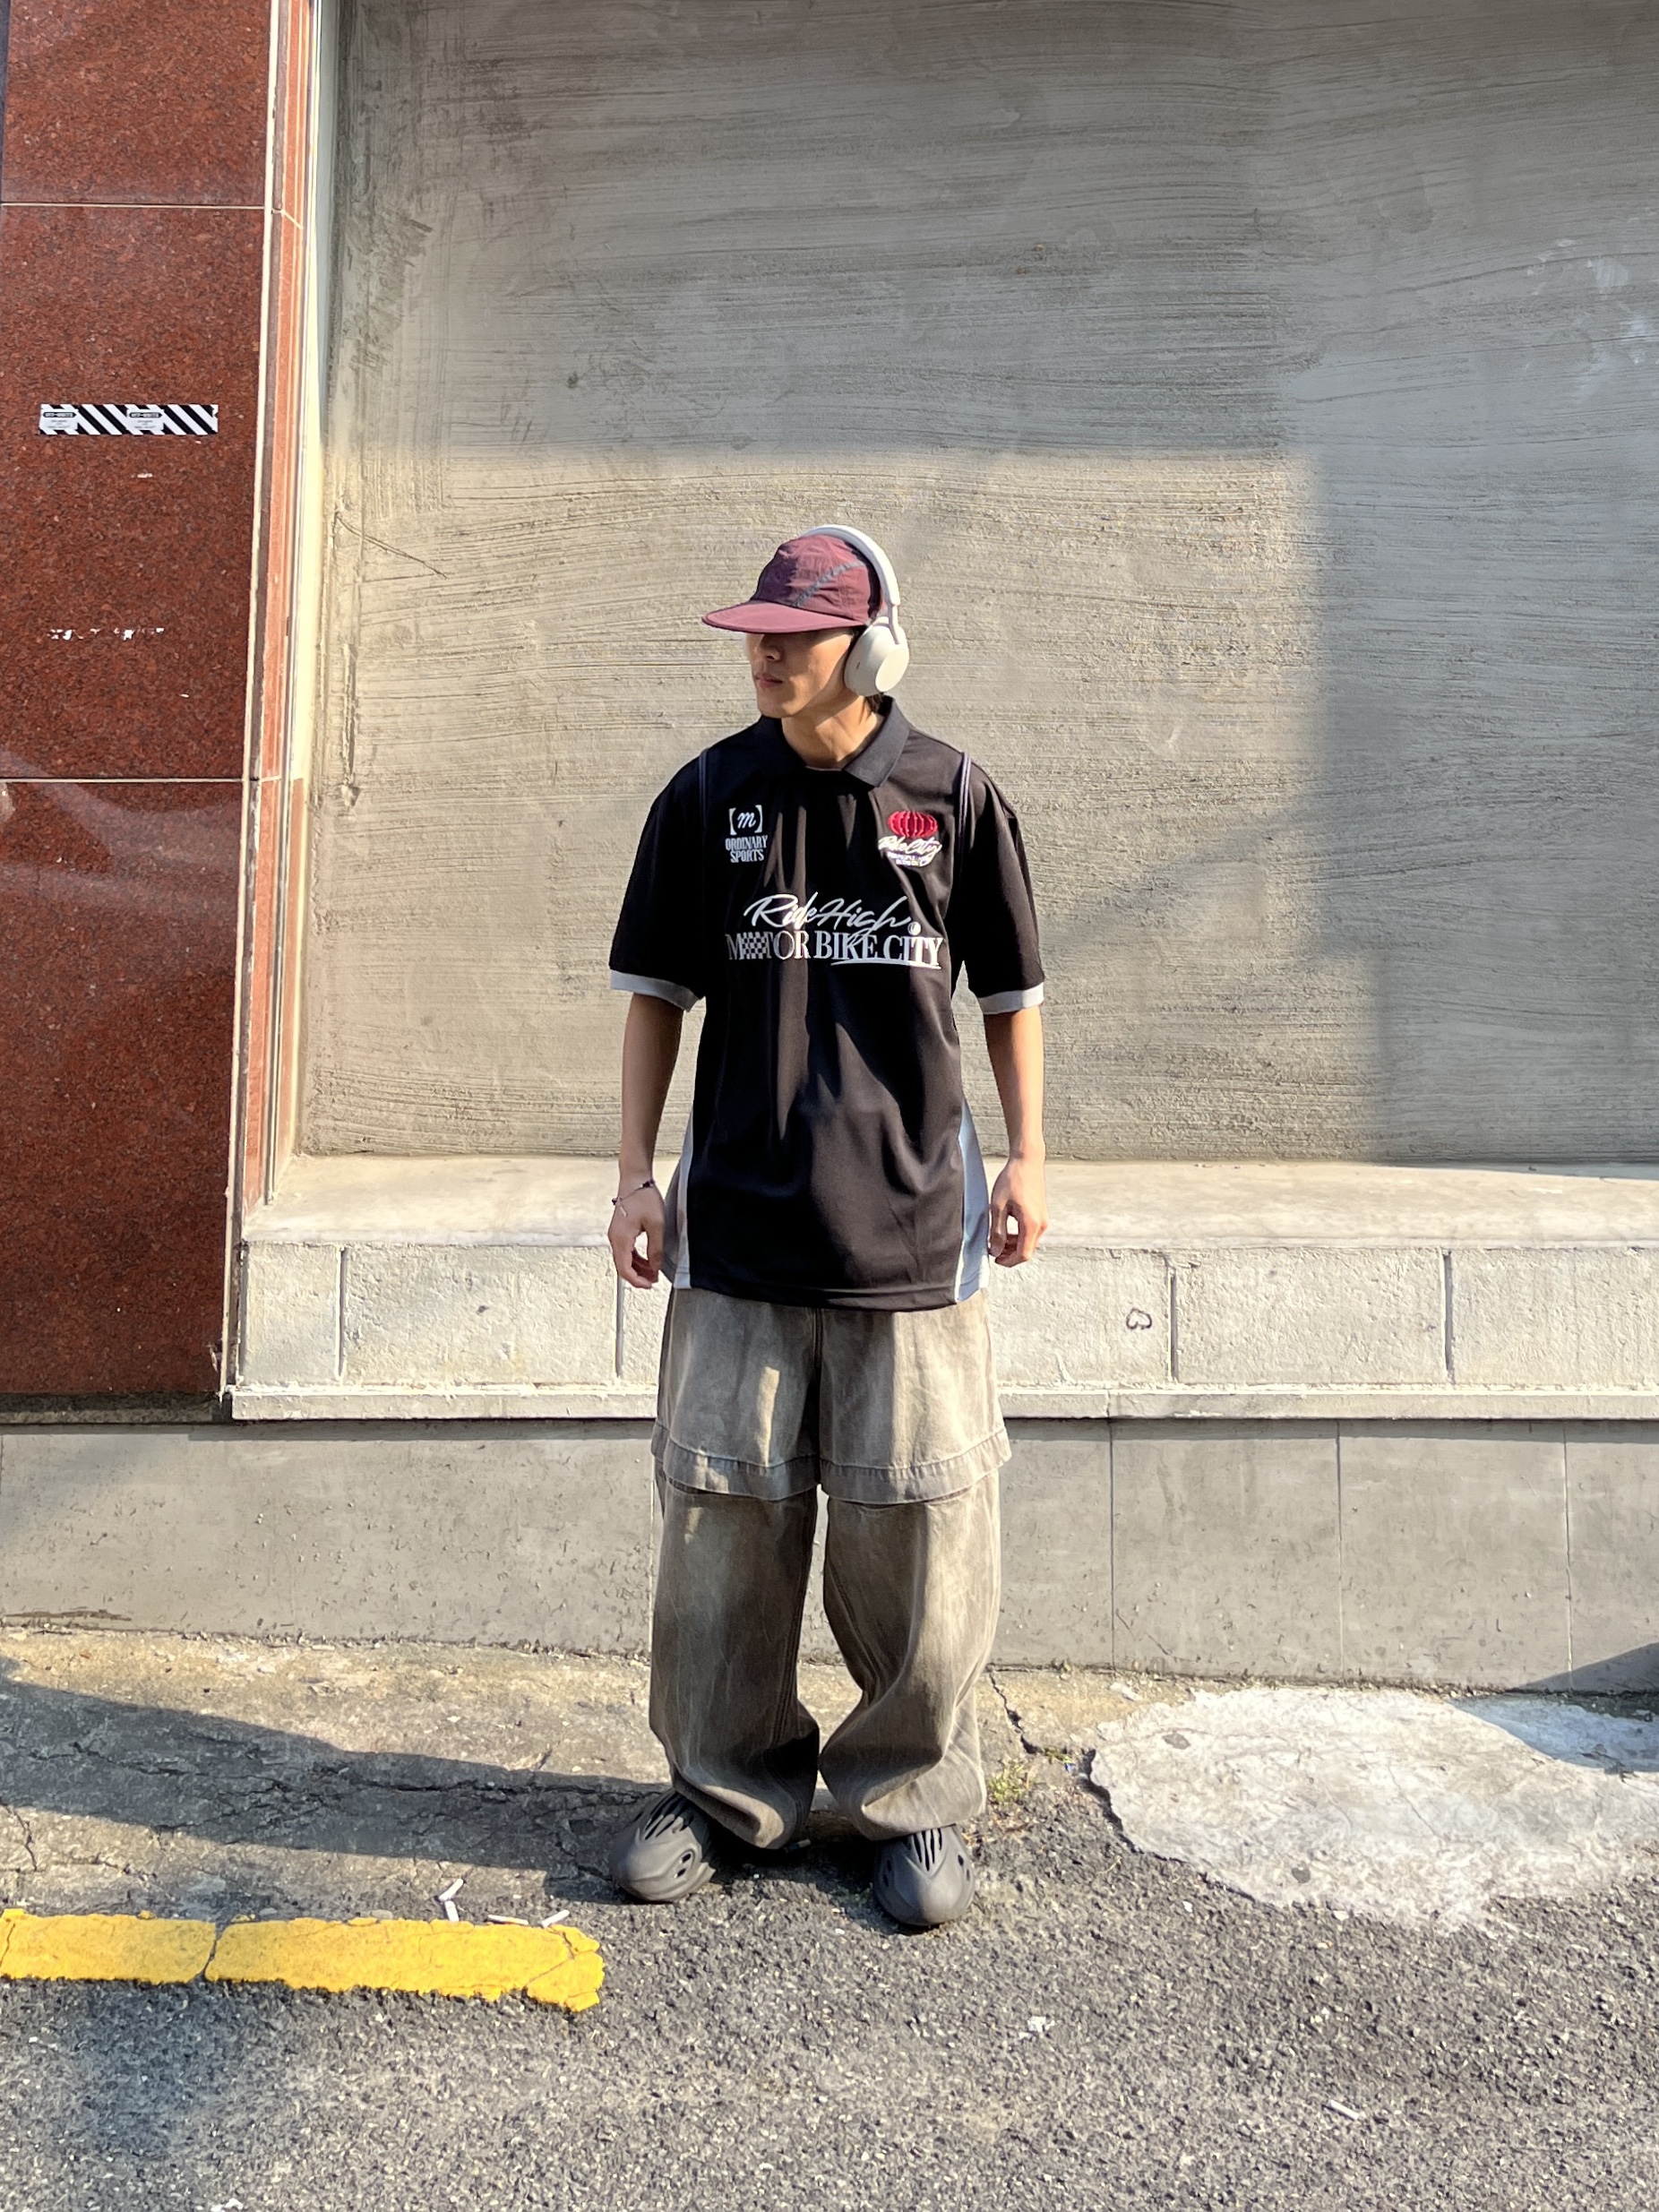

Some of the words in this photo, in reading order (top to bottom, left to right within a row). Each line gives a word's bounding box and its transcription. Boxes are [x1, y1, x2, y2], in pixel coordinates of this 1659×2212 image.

[725, 835, 768, 851] ORDINARY
[730, 848, 764, 863] SPORTS
[725, 930, 810, 960] MTOR
[814, 930, 879, 961] BIKE
[883, 934, 944, 967] CITY
